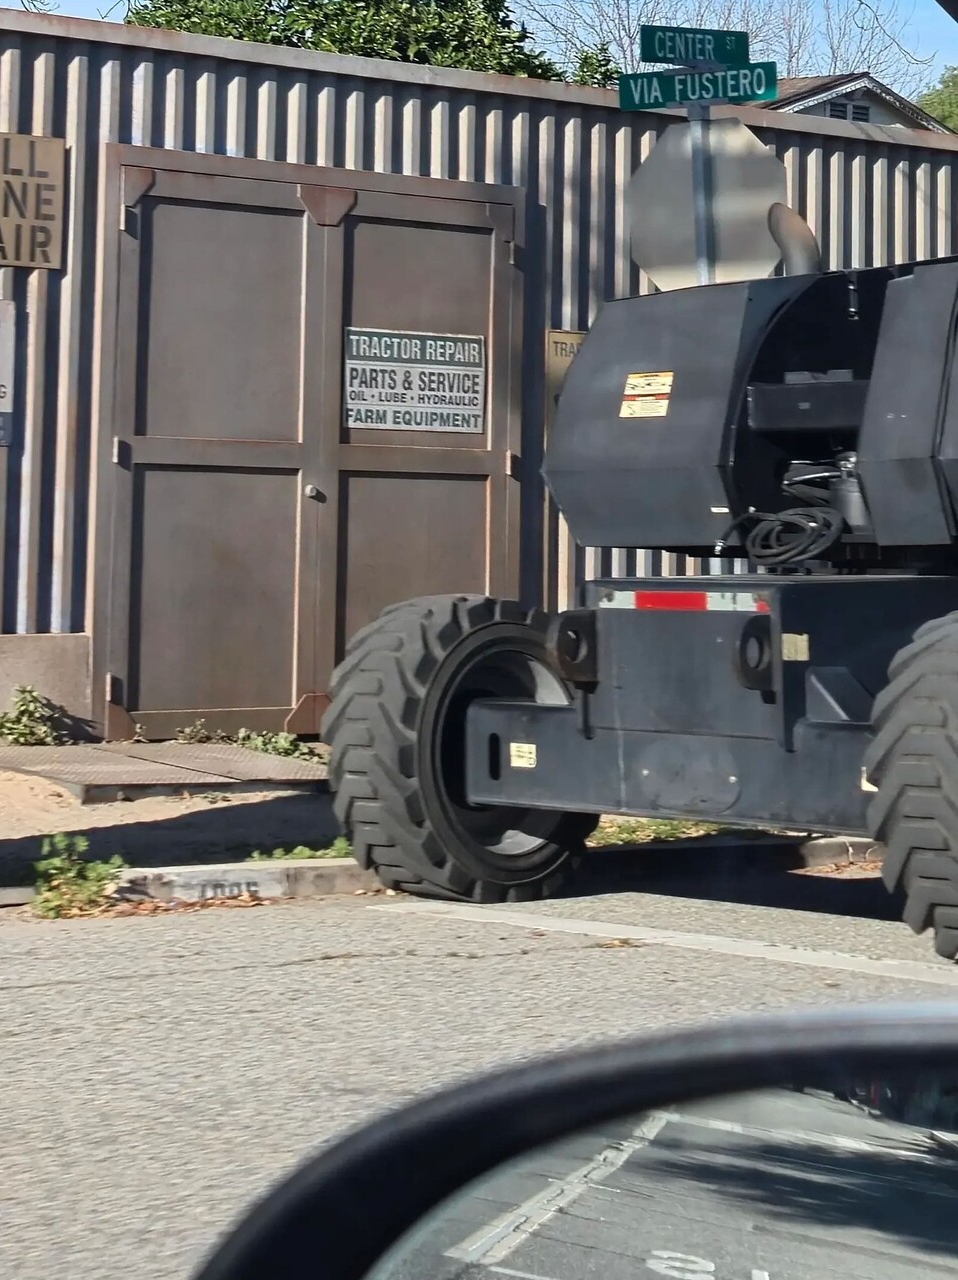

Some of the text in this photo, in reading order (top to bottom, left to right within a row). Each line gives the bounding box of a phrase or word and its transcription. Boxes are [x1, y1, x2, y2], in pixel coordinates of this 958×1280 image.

[654, 31, 736, 61] CENTER ST
[629, 68, 766, 105] VIA FUSTERO
[348, 335, 480, 363] TRACTOR REPAIR
[349, 367, 480, 395] PARTS & SERVICE
[349, 390, 480, 407] OIL LUBE HYDRAULIC
[346, 408, 481, 428] FARM EQUIPMENT
